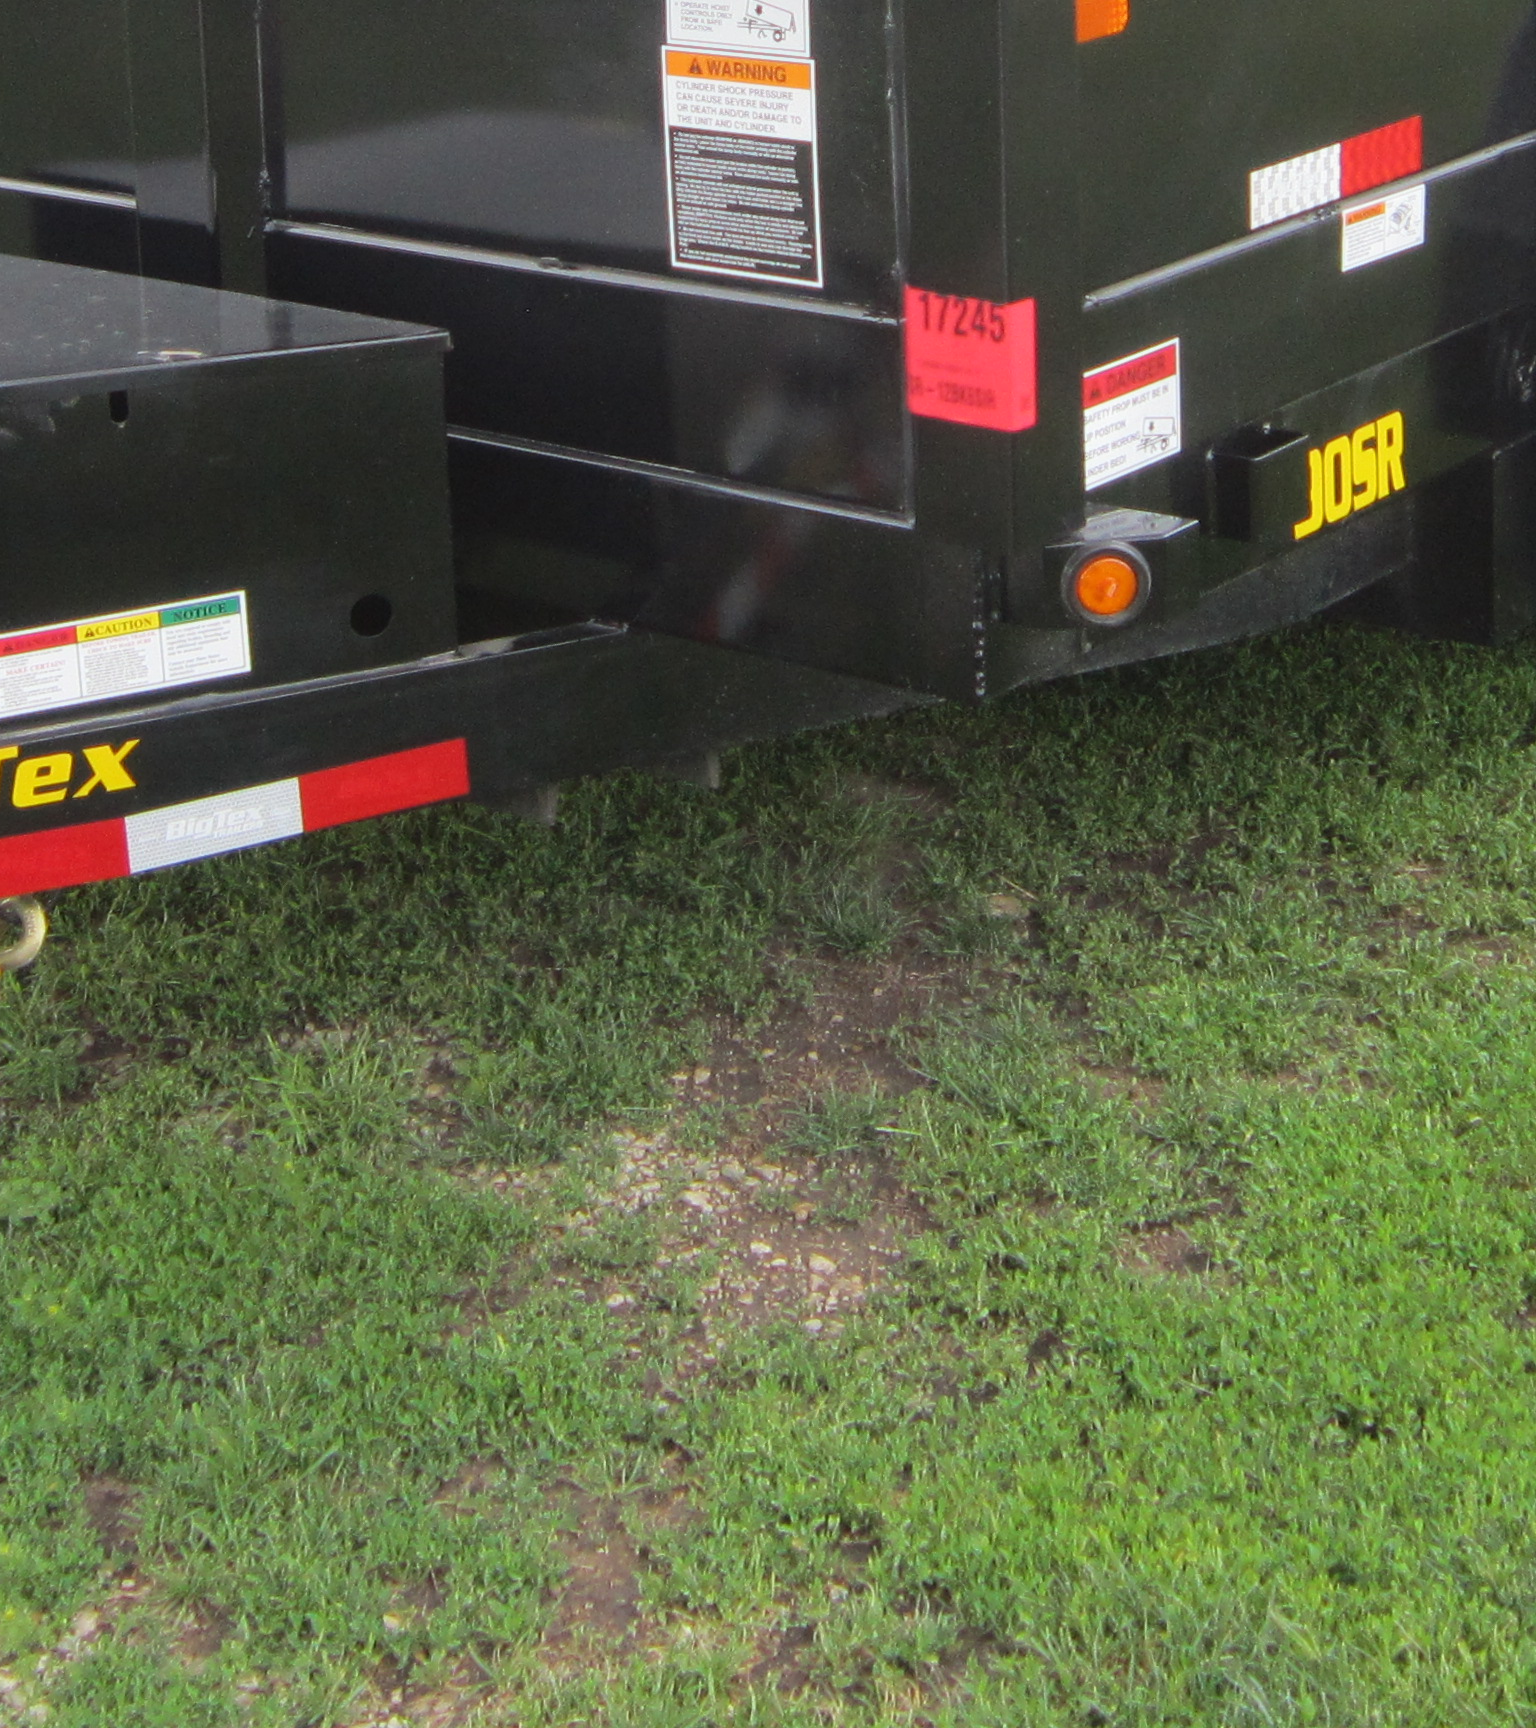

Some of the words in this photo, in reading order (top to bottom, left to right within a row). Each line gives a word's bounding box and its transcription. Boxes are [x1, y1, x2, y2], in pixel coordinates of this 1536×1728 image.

[707, 58, 787, 83] WARNING
[676, 80, 716, 93] CYLINDER
[718, 83, 747, 96] SHOCK
[748, 86, 794, 100] PRESSURE
[676, 92, 694, 102] CAN
[695, 94, 724, 105] CAUSE
[724, 96, 757, 108] SEVERE
[759, 99, 790, 111] INJURY
[677, 103, 689, 112] OR
[691, 104, 717, 116] DEATH
[718, 107, 751, 119] AND/OR
[751, 111, 789, 123] DAMAGE
[790, 115, 803, 125] TO
[677, 115, 693, 125] THE
[694, 116, 714, 127] UNIT
[715, 119, 733, 129] AND
[919, 292, 1006, 343] 17245
[1108, 356, 1166, 394] DANGER
[1112, 400, 1131, 415] PROP
[1131, 391, 1152, 406] MUST
[1094, 420, 1127, 439] POSITION
[172, 602, 227, 623] NOTICE
[95, 617, 153, 636] CAUTION
